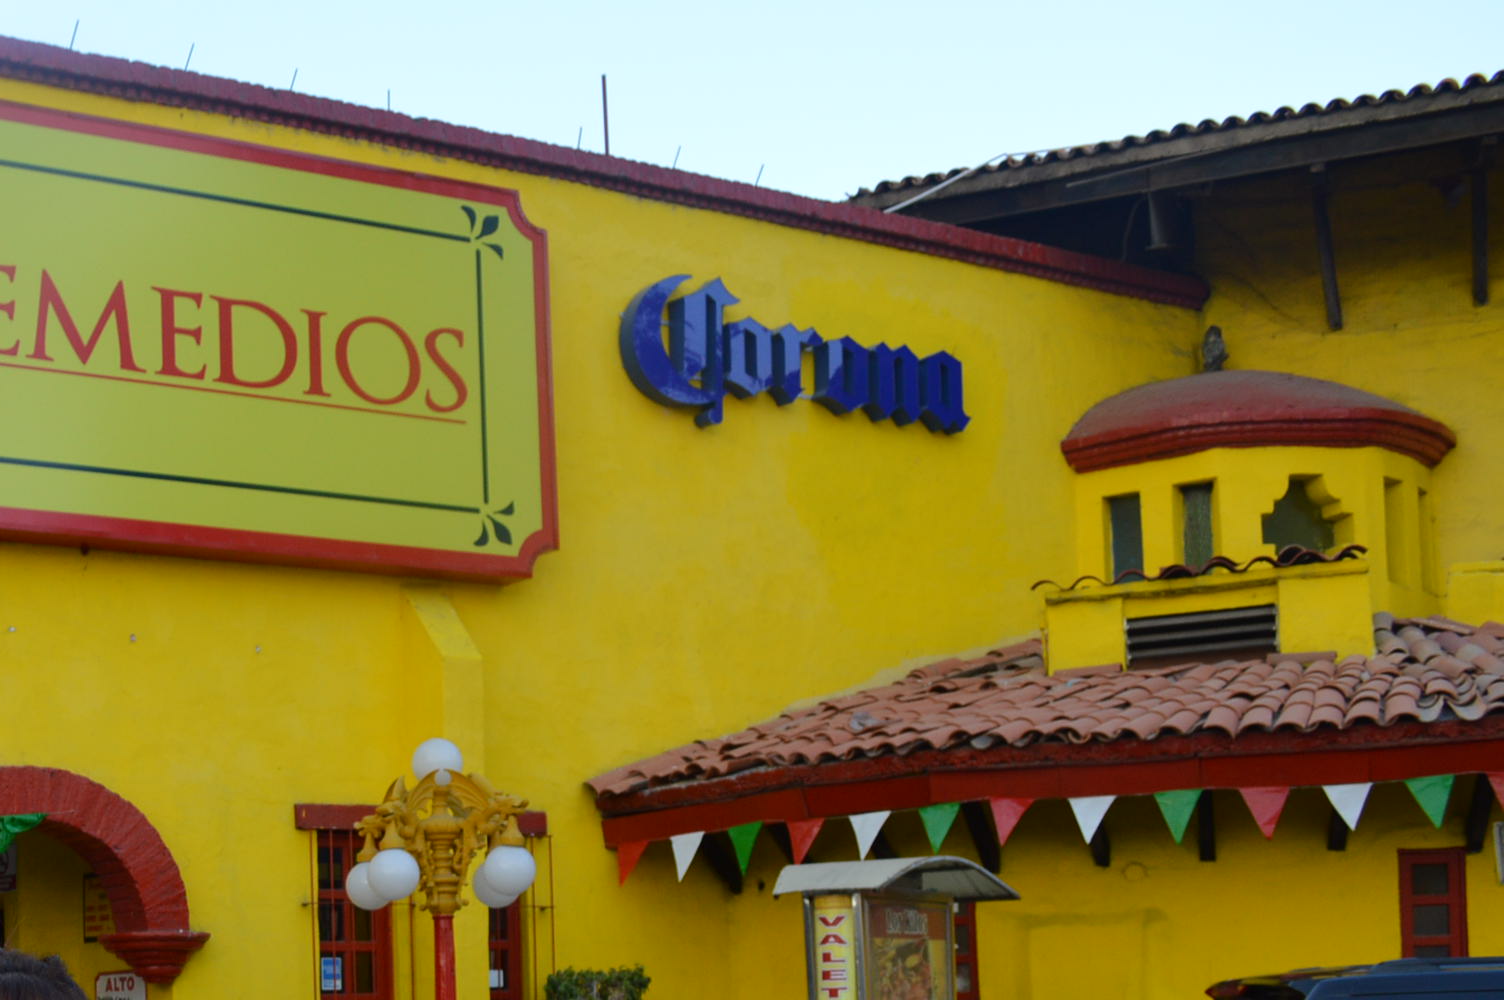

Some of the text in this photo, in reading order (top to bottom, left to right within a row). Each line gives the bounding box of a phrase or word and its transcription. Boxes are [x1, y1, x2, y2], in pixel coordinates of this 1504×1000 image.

[618, 274, 971, 435] Corona
[106, 976, 135, 992] ALTO
[818, 916, 848, 998] VALET
